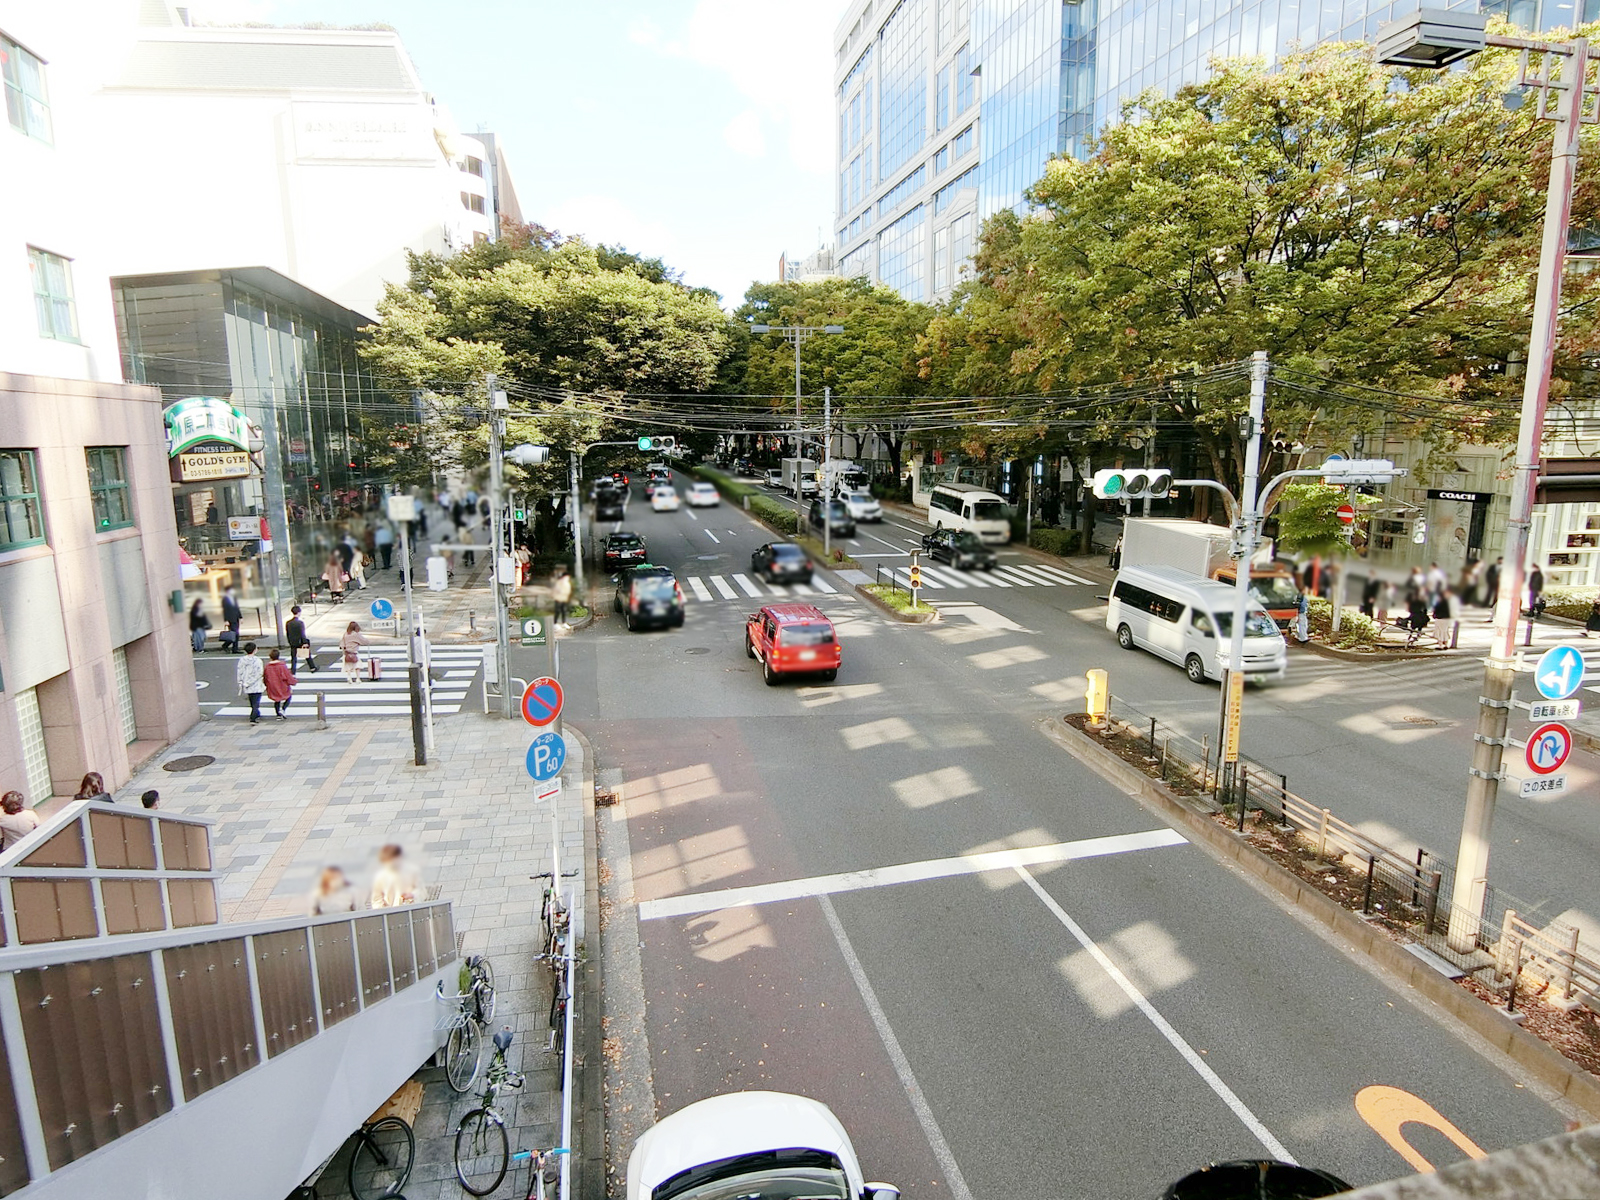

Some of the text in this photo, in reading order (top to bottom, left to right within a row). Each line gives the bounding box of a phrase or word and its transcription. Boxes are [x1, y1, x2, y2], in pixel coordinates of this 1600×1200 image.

[194, 446, 219, 454] FITNESS
[188, 455, 246, 467] GOLD'S GYM
[1439, 492, 1475, 500] COACH
[534, 678, 549, 688] 20-9
[1533, 704, 1576, 718] 自転車を除く
[536, 734, 554, 745] 9-20
[534, 744, 551, 777] P
[1524, 778, 1563, 792] この交差点
